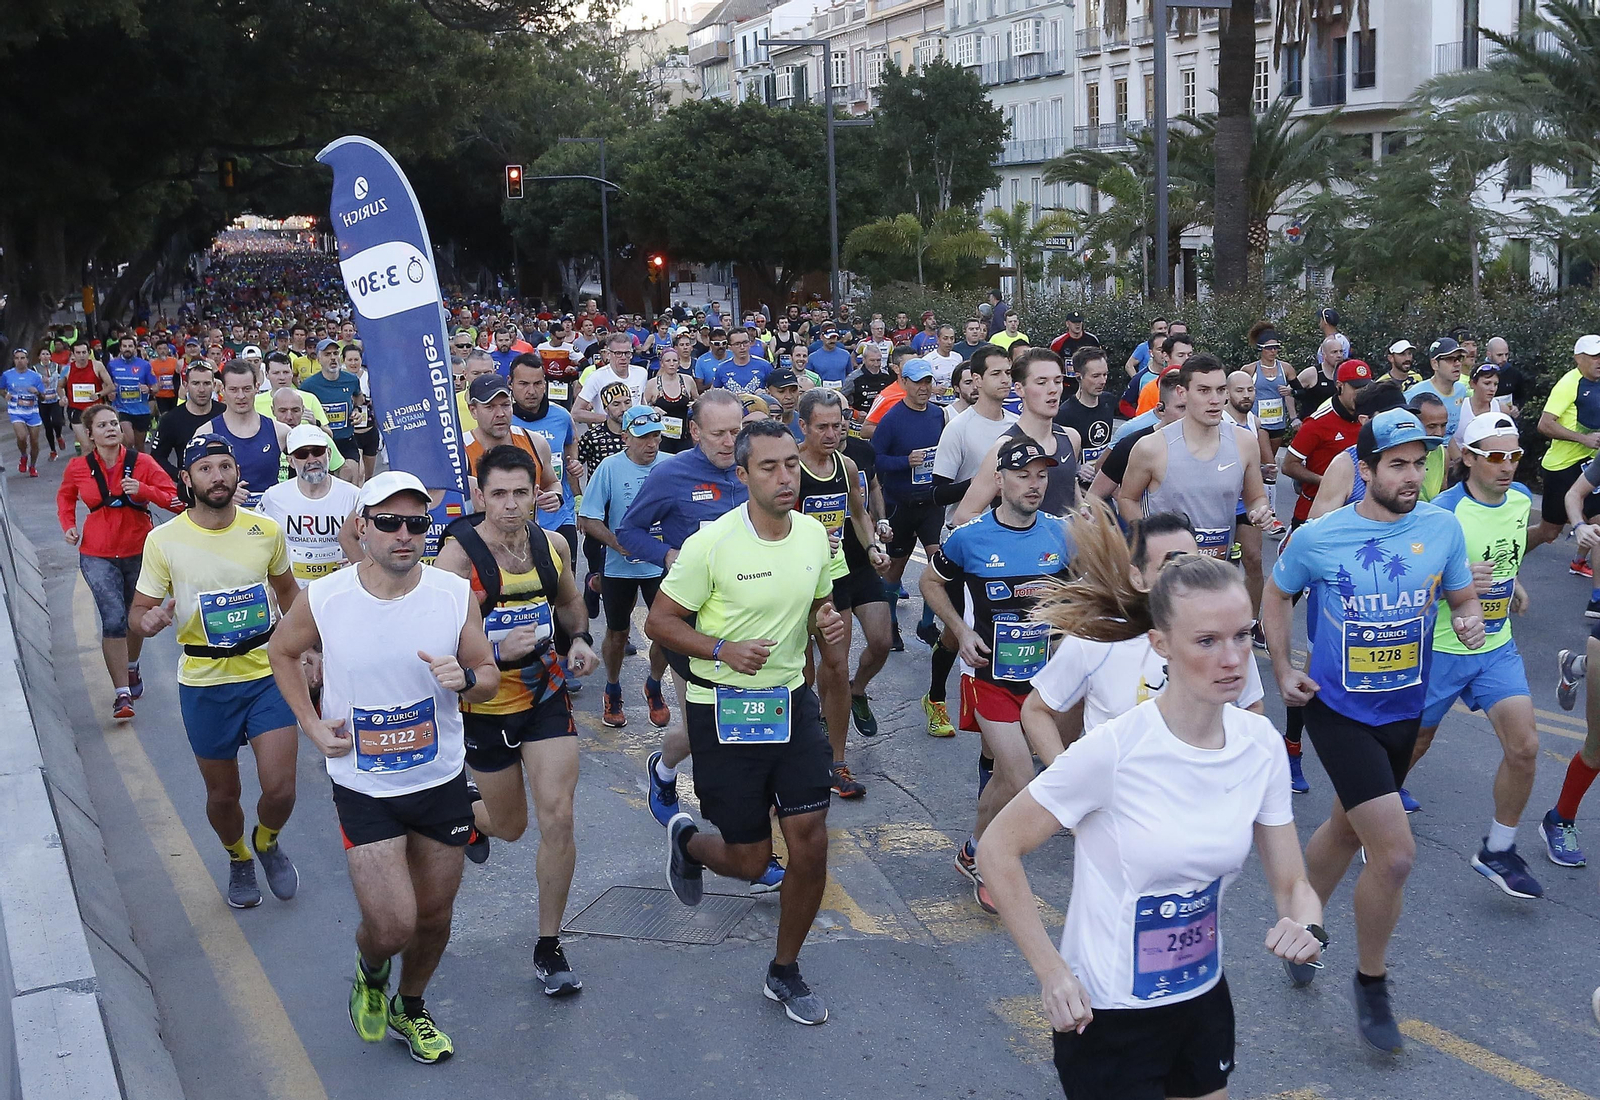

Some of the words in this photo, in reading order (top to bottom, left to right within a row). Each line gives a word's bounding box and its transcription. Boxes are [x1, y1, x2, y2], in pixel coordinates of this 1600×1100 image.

[818, 513, 837, 522] 1292
[314, 551, 336, 559] ZURICH
[306, 564, 328, 573] 5691
[737, 570, 773, 582] Oussama
[228, 593, 254, 602] ZURICH
[1341, 589, 1427, 612] MITLAB
[227, 610, 248, 624] 627
[493, 611, 541, 622] ZURICH
[1387, 607, 1416, 617] SPORT
[1377, 629, 1407, 640] ZURICH
[1017, 646, 1035, 657] 770
[1369, 649, 1402, 663] 1278
[741, 702, 766, 714] 738
[387, 710, 419, 722] ZURICH
[379, 729, 416, 747] 2122
[1179, 896, 1211, 912] ZURICH
[1167, 927, 1202, 952] 2935
